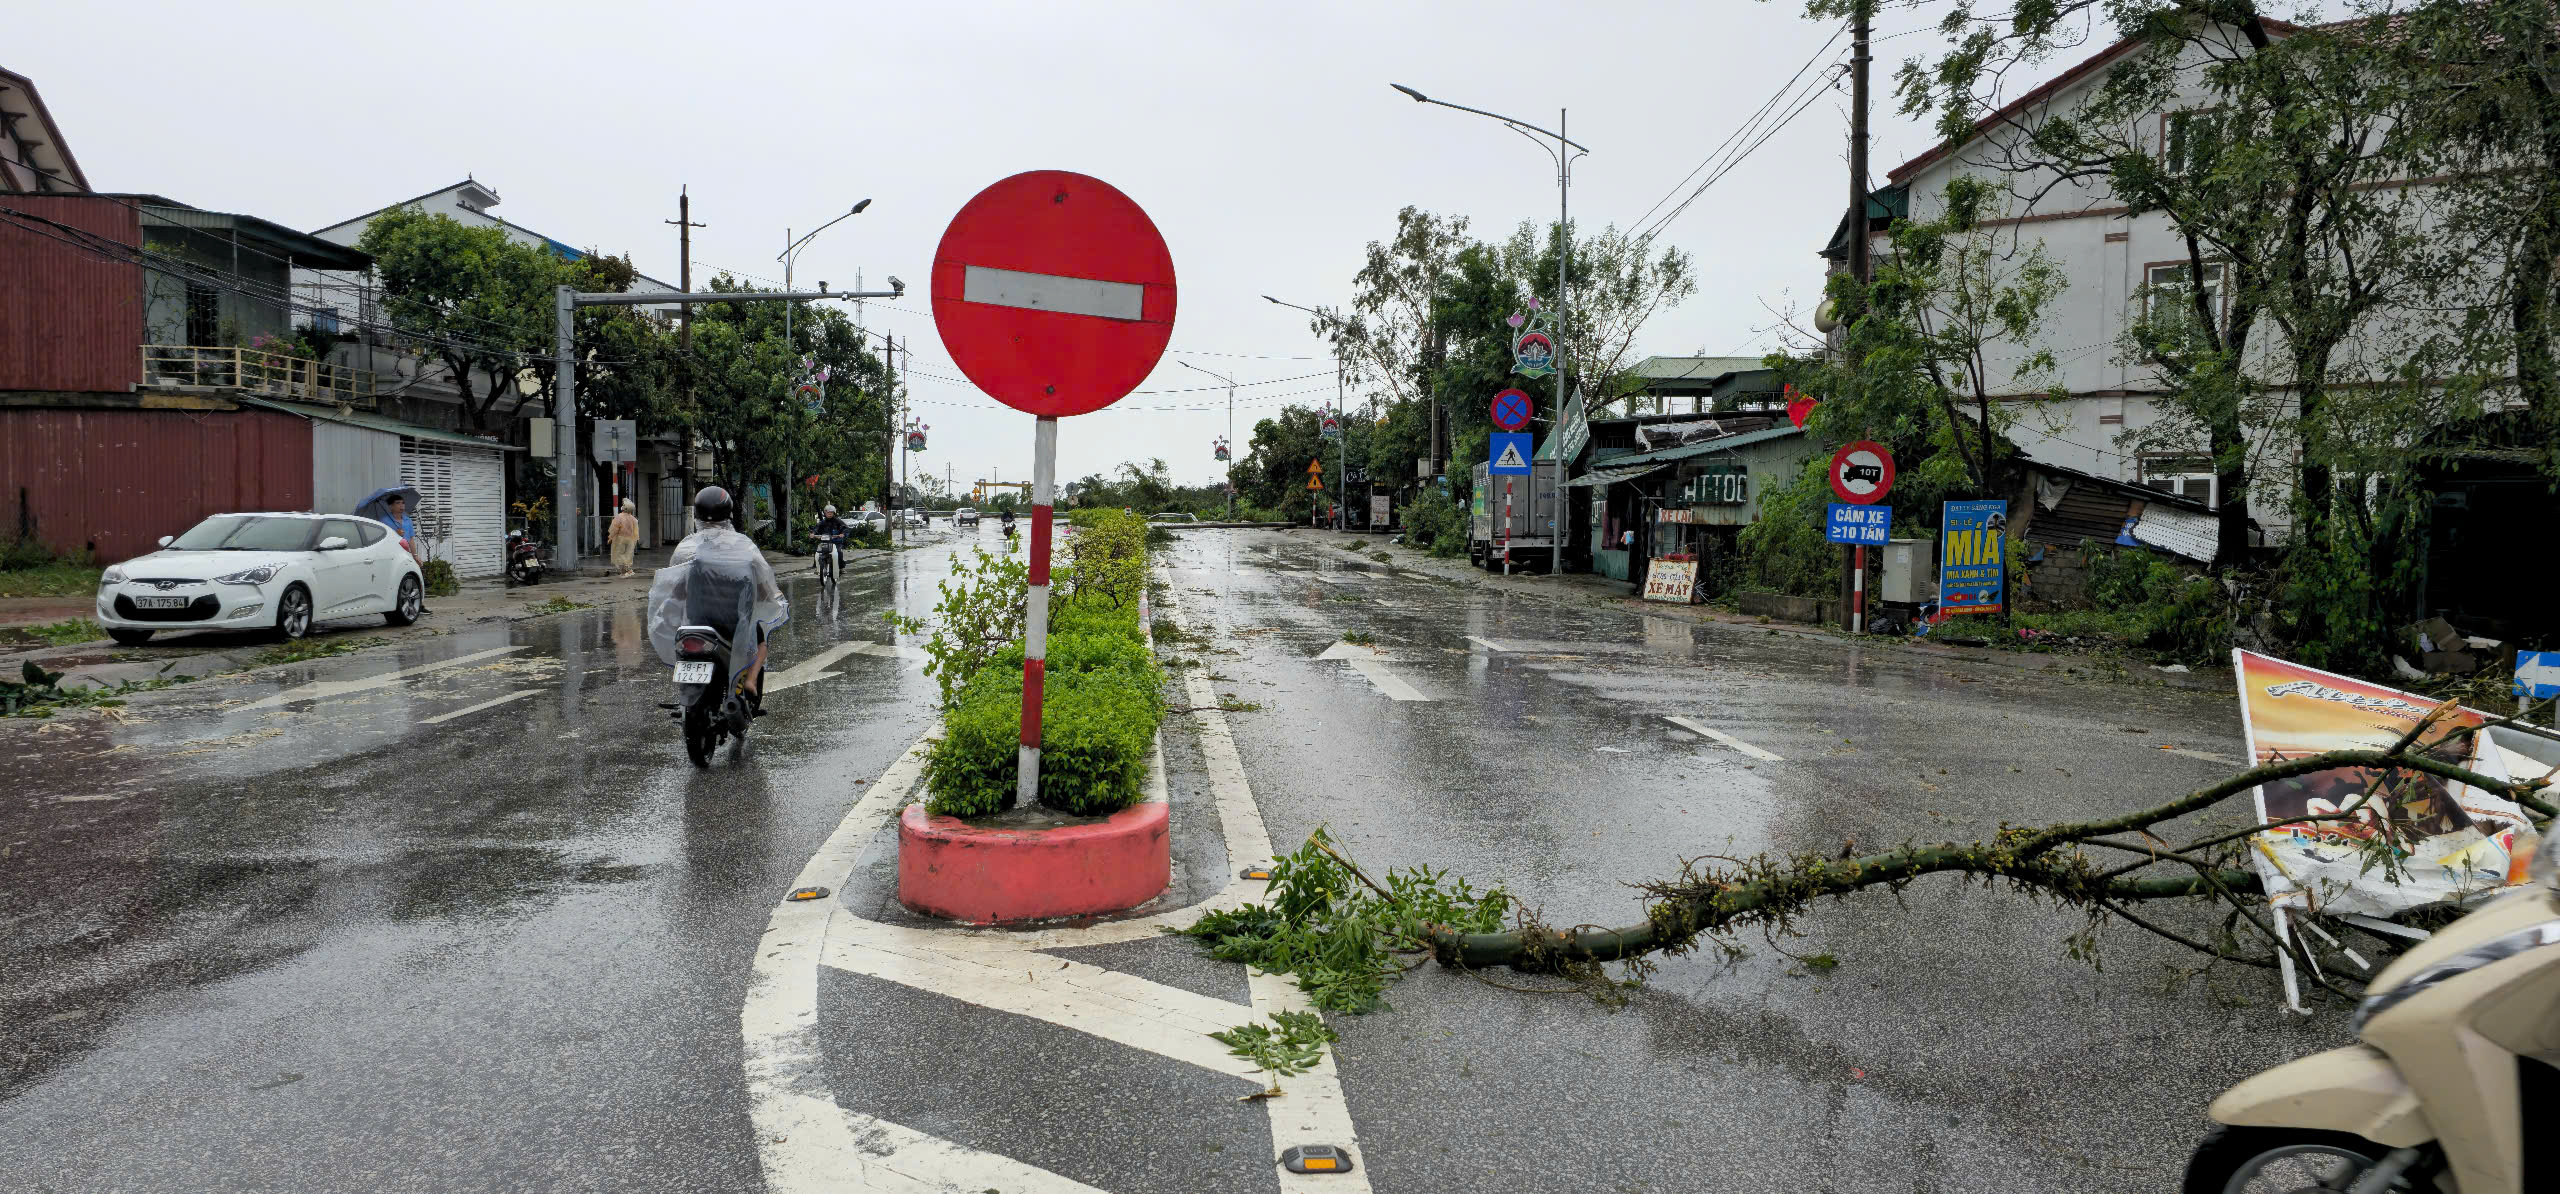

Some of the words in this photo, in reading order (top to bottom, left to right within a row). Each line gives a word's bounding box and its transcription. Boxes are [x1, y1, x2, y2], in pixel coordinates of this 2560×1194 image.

[1860, 468, 1878, 477] 10T
[1836, 505, 1865, 523] CẤM
[1868, 511, 1885, 524] XE
[1860, 523, 1885, 541] TẤN
[1946, 522, 2000, 566] MÍA
[1665, 581, 1691, 596] MÁY
[681, 663, 707, 672] 38-F1
